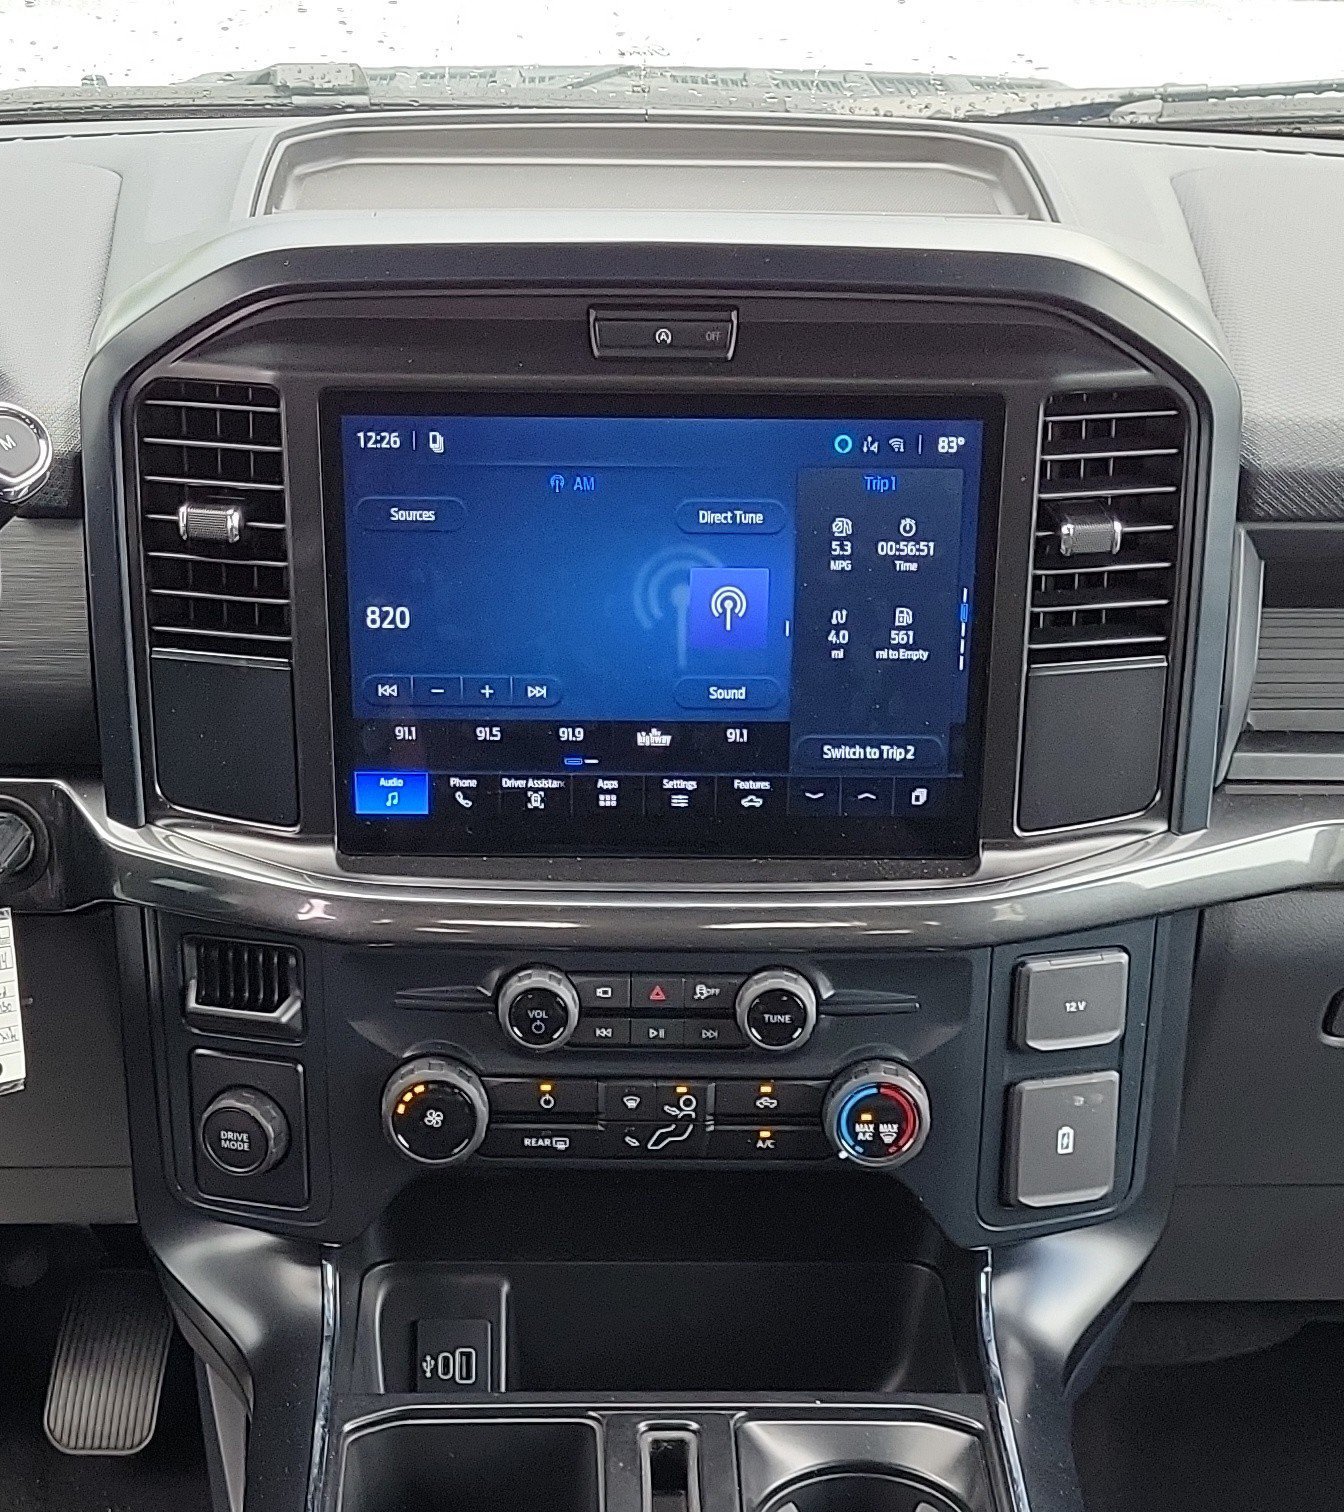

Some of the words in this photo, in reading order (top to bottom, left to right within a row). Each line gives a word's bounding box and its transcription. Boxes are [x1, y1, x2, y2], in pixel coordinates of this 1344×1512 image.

[356, 432, 400, 449] 12:26
[937, 436, 965, 453] 83°
[573, 476, 595, 491] AM
[863, 475, 889, 492] Trip
[890, 476, 897, 491] 1
[390, 507, 436, 521] Sources
[698, 510, 732, 525] Direct
[734, 510, 764, 525] Tune
[831, 541, 852, 556] 5.3
[877, 541, 935, 556] 00:56:51
[830, 560, 852, 571] MPG
[895, 560, 918, 572] Time
[366, 606, 411, 629] 820
[828, 630, 849, 645] 4.0
[890, 630, 914, 645] 561
[831, 649, 844, 659] mi
[875, 649, 888, 659] mi
[888, 649, 898, 659] to
[899, 649, 929, 662] Empty
[709, 686, 746, 700] Sound
[395, 726, 416, 740] 91.1
[475, 726, 501, 741] 91.5
[559, 727, 584, 741] 91.9
[726, 728, 748, 742] 91.1
[822, 745, 865, 760] Switch
[866, 746, 880, 759] to
[881, 745, 905, 760] Trip
[905, 746, 915, 760] 2
[379, 777, 404, 787] Audio
[450, 777, 477, 788] Phone
[501, 778, 526, 788] Driver
[597, 778, 618, 790] Apps
[662, 779, 698, 790] Settings
[734, 779, 771, 790] Features
[527, 1009, 549, 1020] VOL
[763, 1013, 792, 1025] TUNE
[855, 1123, 875, 1133] MAX
[879, 1123, 899, 1133] MAX
[220, 1131, 250, 1142] DRIVE
[524, 1137, 551, 1147] REAR
[857, 1132, 873, 1141] A/C
[221, 1141, 250, 1152] MODE
[756, 1139, 775, 1149] A/C
